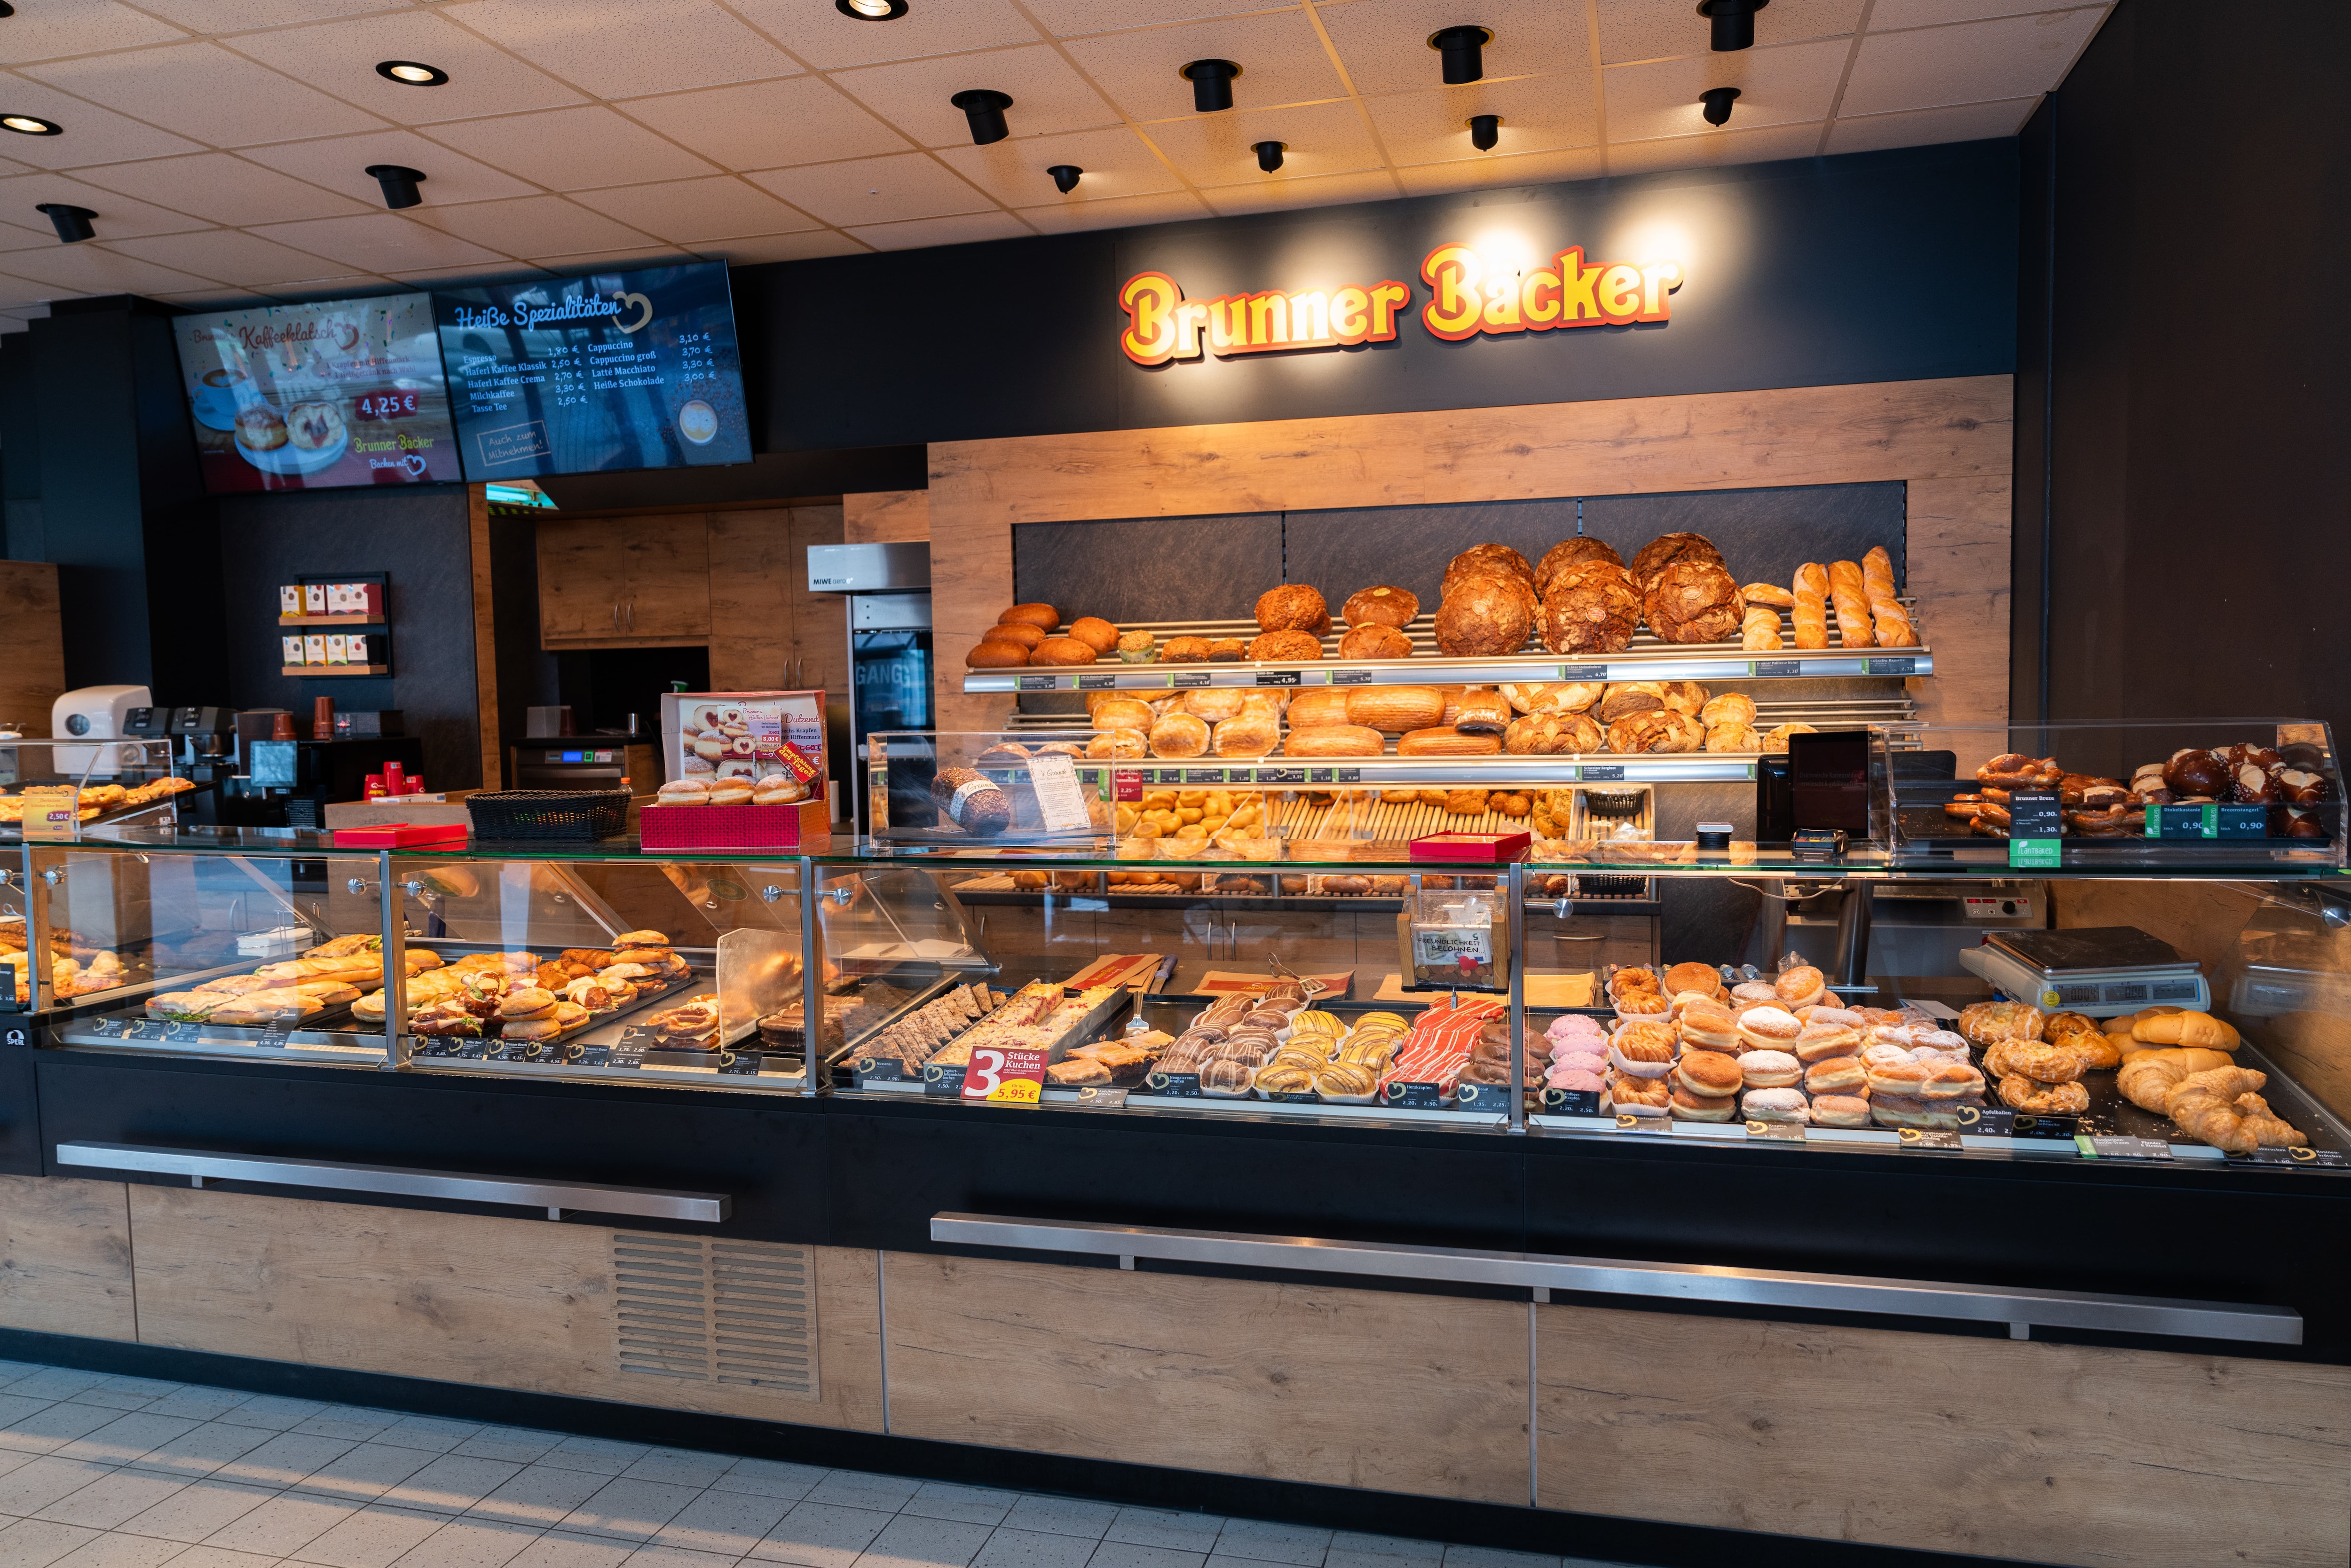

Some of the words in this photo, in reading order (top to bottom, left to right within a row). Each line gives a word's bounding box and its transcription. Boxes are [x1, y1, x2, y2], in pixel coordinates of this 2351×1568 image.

[455, 306, 510, 331] Heiße
[513, 293, 622, 332] Spezialitäten
[1122, 273, 1408, 362] Brunner
[239, 319, 338, 350] Kaffeeklatsch
[679, 333, 699, 345] 3,10
[548, 347, 568, 357] 1,80
[588, 341, 633, 353] Cappuccino
[682, 347, 701, 358] 3,70
[371, 355, 410, 365] Hiffenmark
[463, 355, 497, 364] Espresso
[590, 353, 635, 366] Cappuccino
[637, 350, 656, 362] groß
[465, 366, 490, 376] Haferl
[491, 364, 517, 374] Kaffee
[518, 361, 547, 372] Klassik
[592, 368, 613, 378] Latté
[614, 365, 656, 376] Macchiato
[682, 360, 702, 371] 3,30
[340, 369, 381, 378] Heißgetränk
[554, 371, 572, 383] 2,70
[684, 372, 704, 384] 3,00
[467, 379, 492, 389] Haferl
[494, 377, 519, 387] Kaffee
[521, 375, 545, 384] Crema
[593, 380, 618, 390] Heiße
[619, 376, 665, 388] Schokolade
[470, 390, 515, 401] Milchkaffee
[555, 384, 575, 395] 3,30
[362, 396, 400, 416] 4,25
[403, 395, 416, 411] €
[472, 404, 493, 413] Tasse
[495, 403, 507, 411] Tee
[354, 437, 397, 453] Brunner
[397, 434, 435, 450] Bäcker
[489, 433, 513, 447] Auch
[516, 431, 536, 441] zum
[488, 439, 544, 460] Mitnehmen!
[369, 457, 396, 469] Backen
[396, 457, 408, 468] mit
[785, 712, 820, 724] Dutzend
[779, 749, 792, 761] des
[792, 758, 813, 778] Tages
[782, 745, 816, 774] Empfehlung
[813, 756, 820, 765] €
[1007, 1051, 1040, 1061] Stücke
[1005, 1060, 1041, 1070] Kuchen
[964, 1050, 1005, 1096] 3
[998, 1088, 1025, 1100] 5,95
[1028, 1090, 1036, 1099] €
